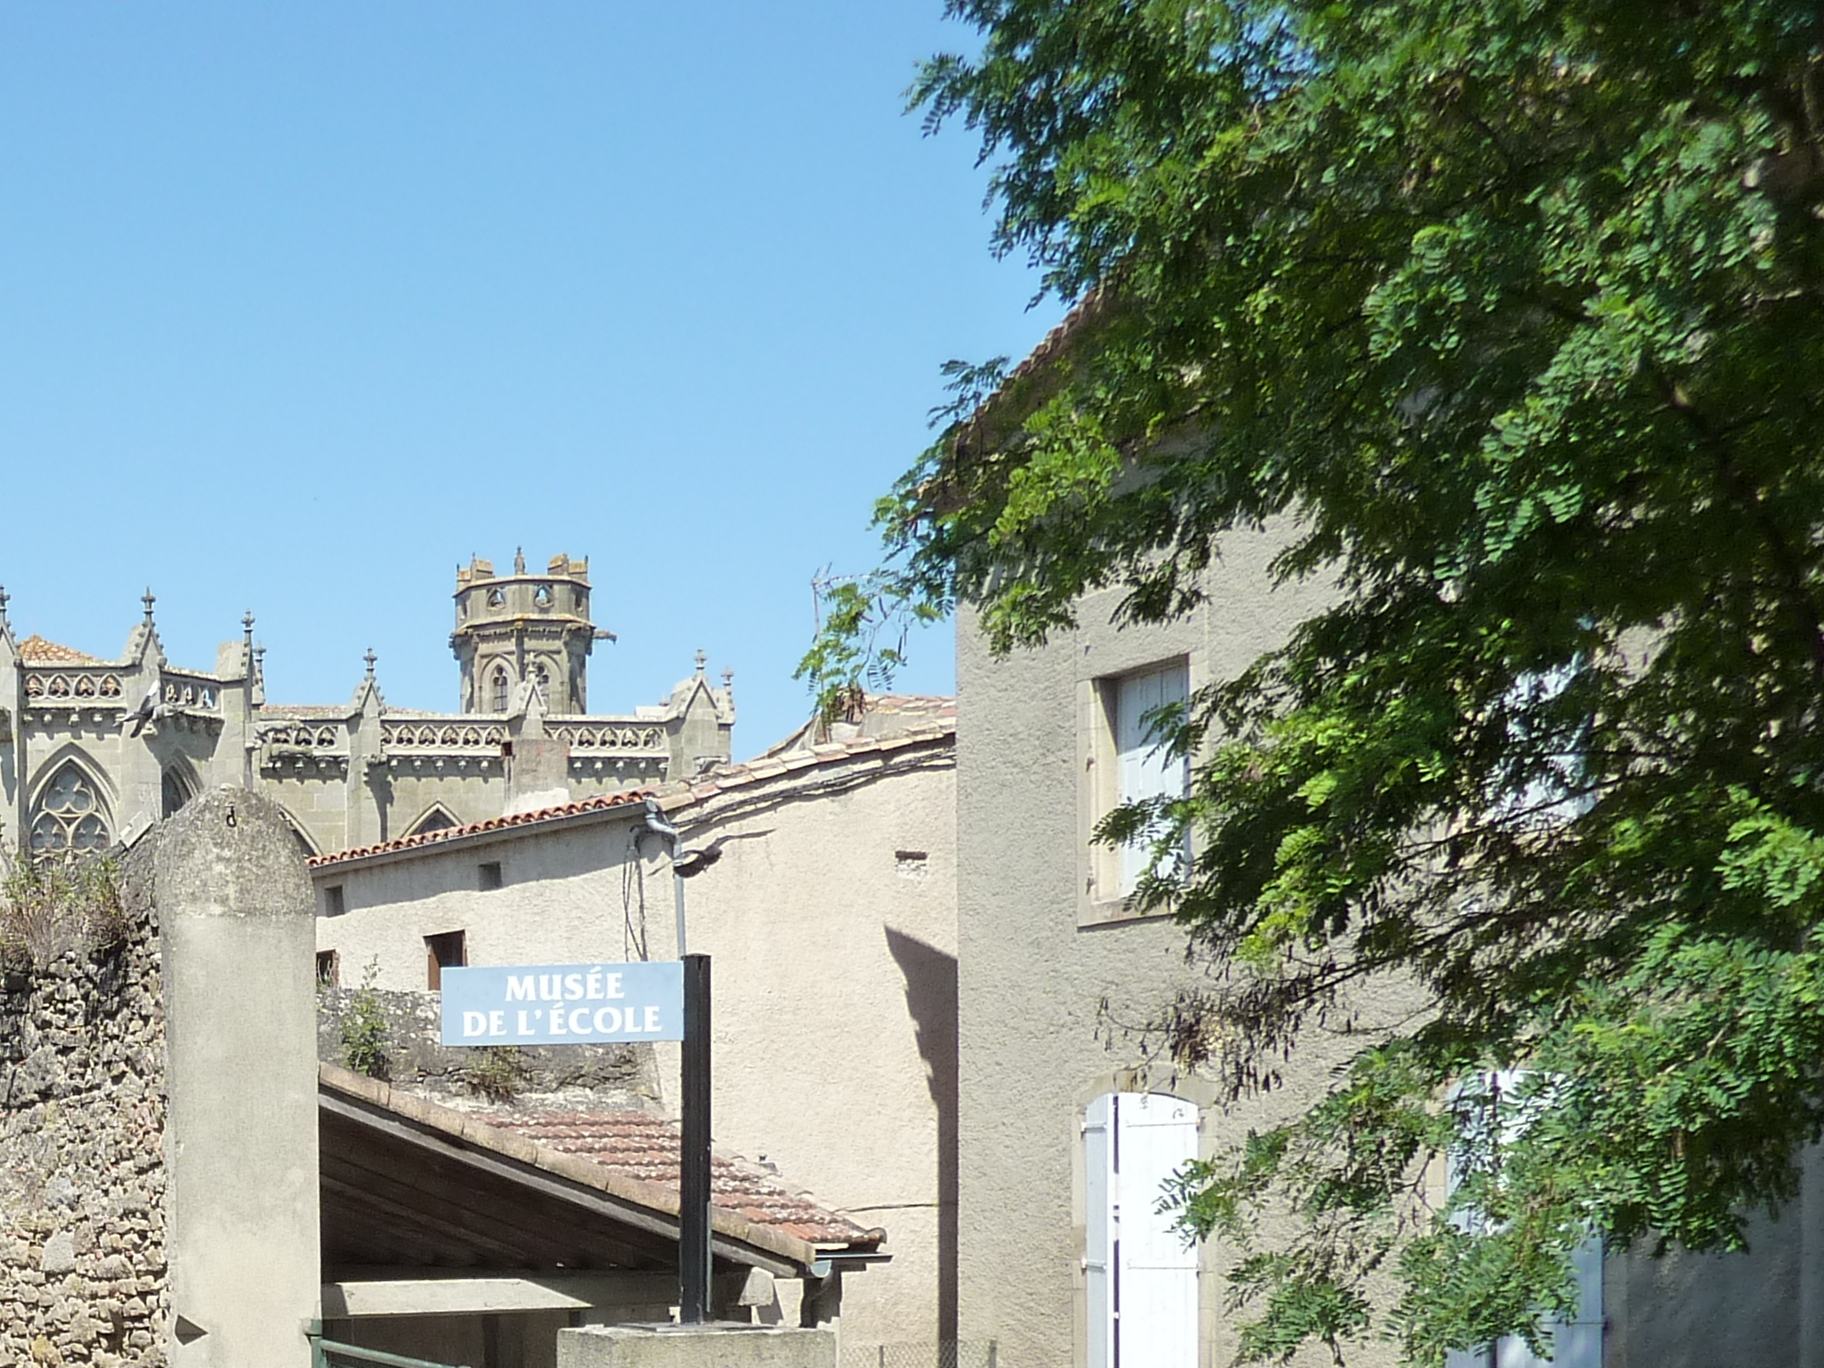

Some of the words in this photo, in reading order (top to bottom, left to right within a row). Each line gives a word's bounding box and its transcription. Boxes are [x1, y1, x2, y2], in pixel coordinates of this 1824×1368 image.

[506, 967, 625, 1001] MUSÉE
[462, 1010, 507, 1038] DE
[517, 1002, 663, 1036] L'ÉCOLE
